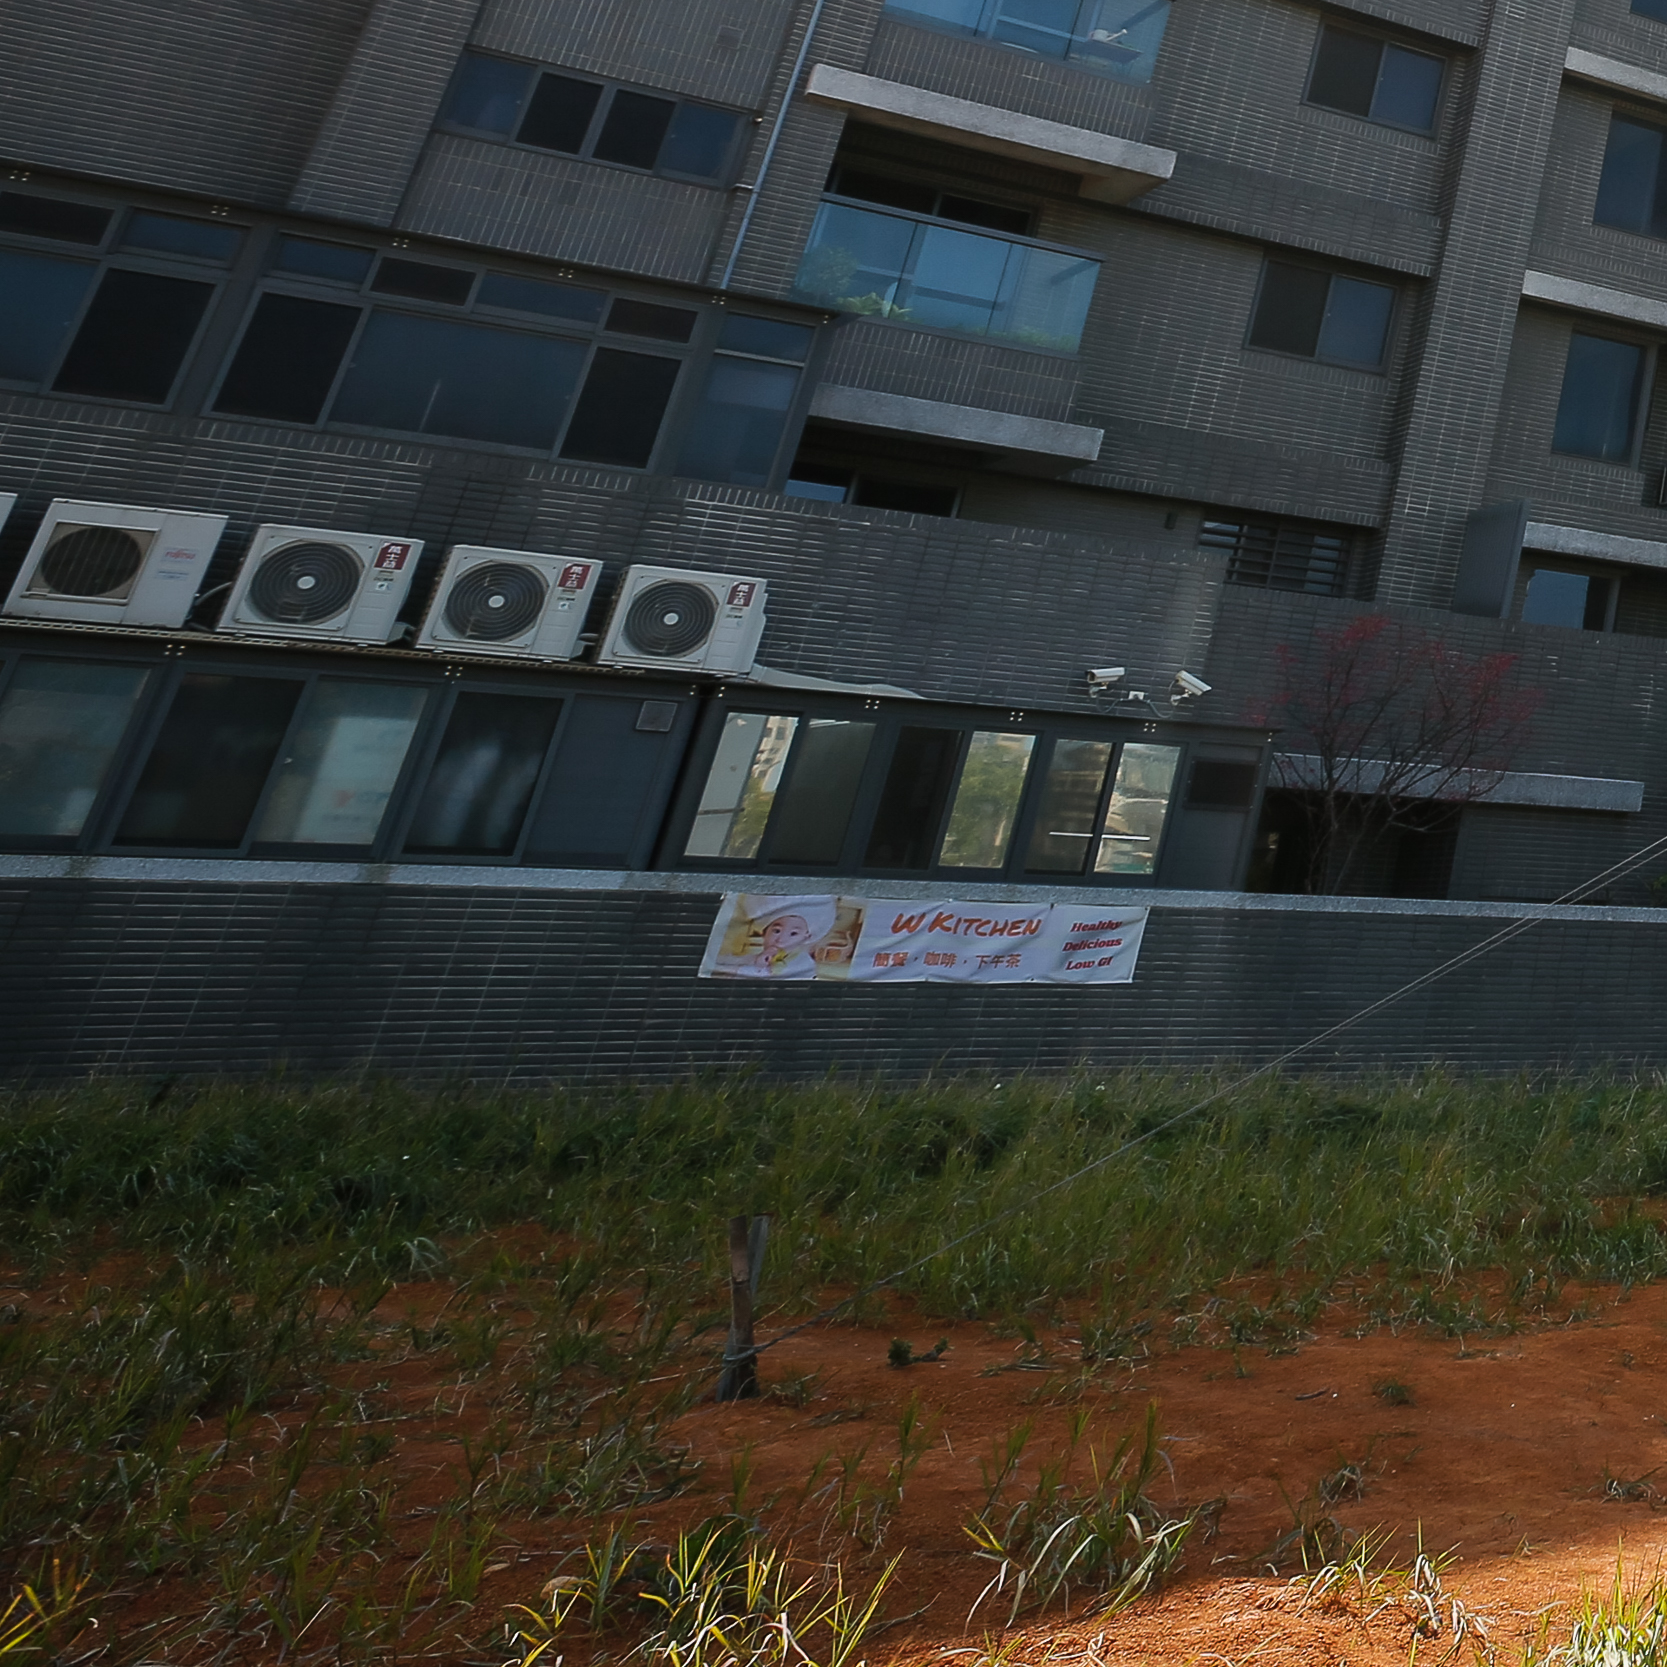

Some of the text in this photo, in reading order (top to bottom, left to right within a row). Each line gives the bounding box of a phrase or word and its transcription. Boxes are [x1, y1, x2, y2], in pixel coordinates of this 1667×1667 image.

[891, 911, 1042, 937] W KITCHEN
[1070, 919, 1123, 933] Healthy
[1062, 936, 1123, 952] Delicious
[1065, 958, 1096, 971] Low
